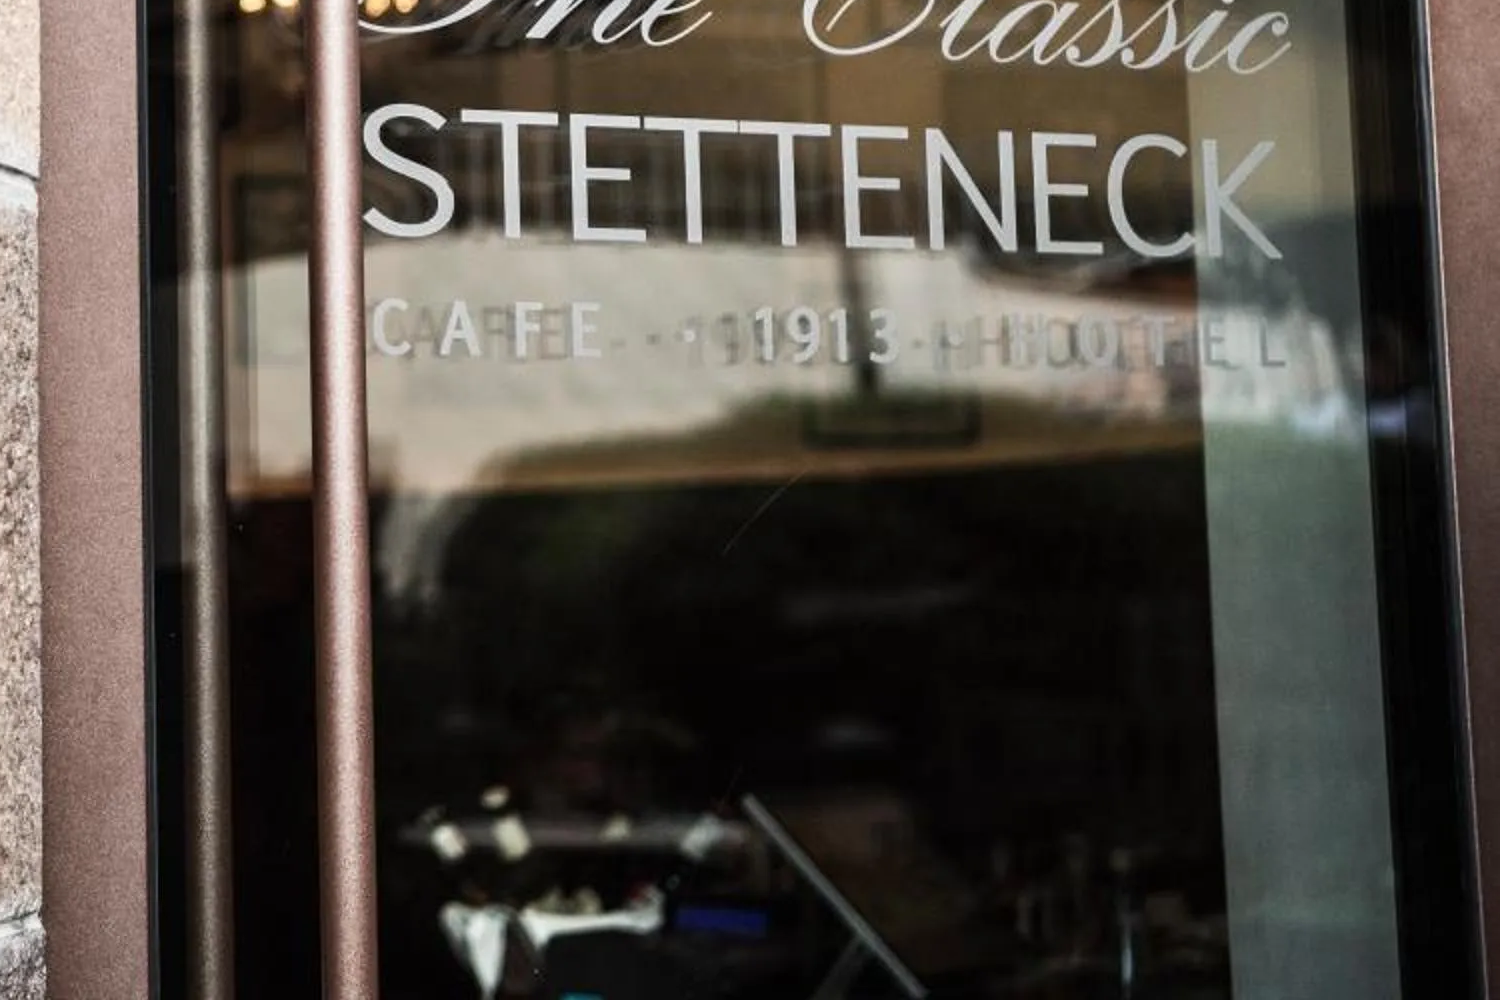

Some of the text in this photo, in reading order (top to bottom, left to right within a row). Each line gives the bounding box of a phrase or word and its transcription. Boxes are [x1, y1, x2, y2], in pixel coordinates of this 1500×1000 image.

[362, 103, 1283, 260] STETTENECK
[371, 298, 1288, 369] CAFE 1913 HOTEL
